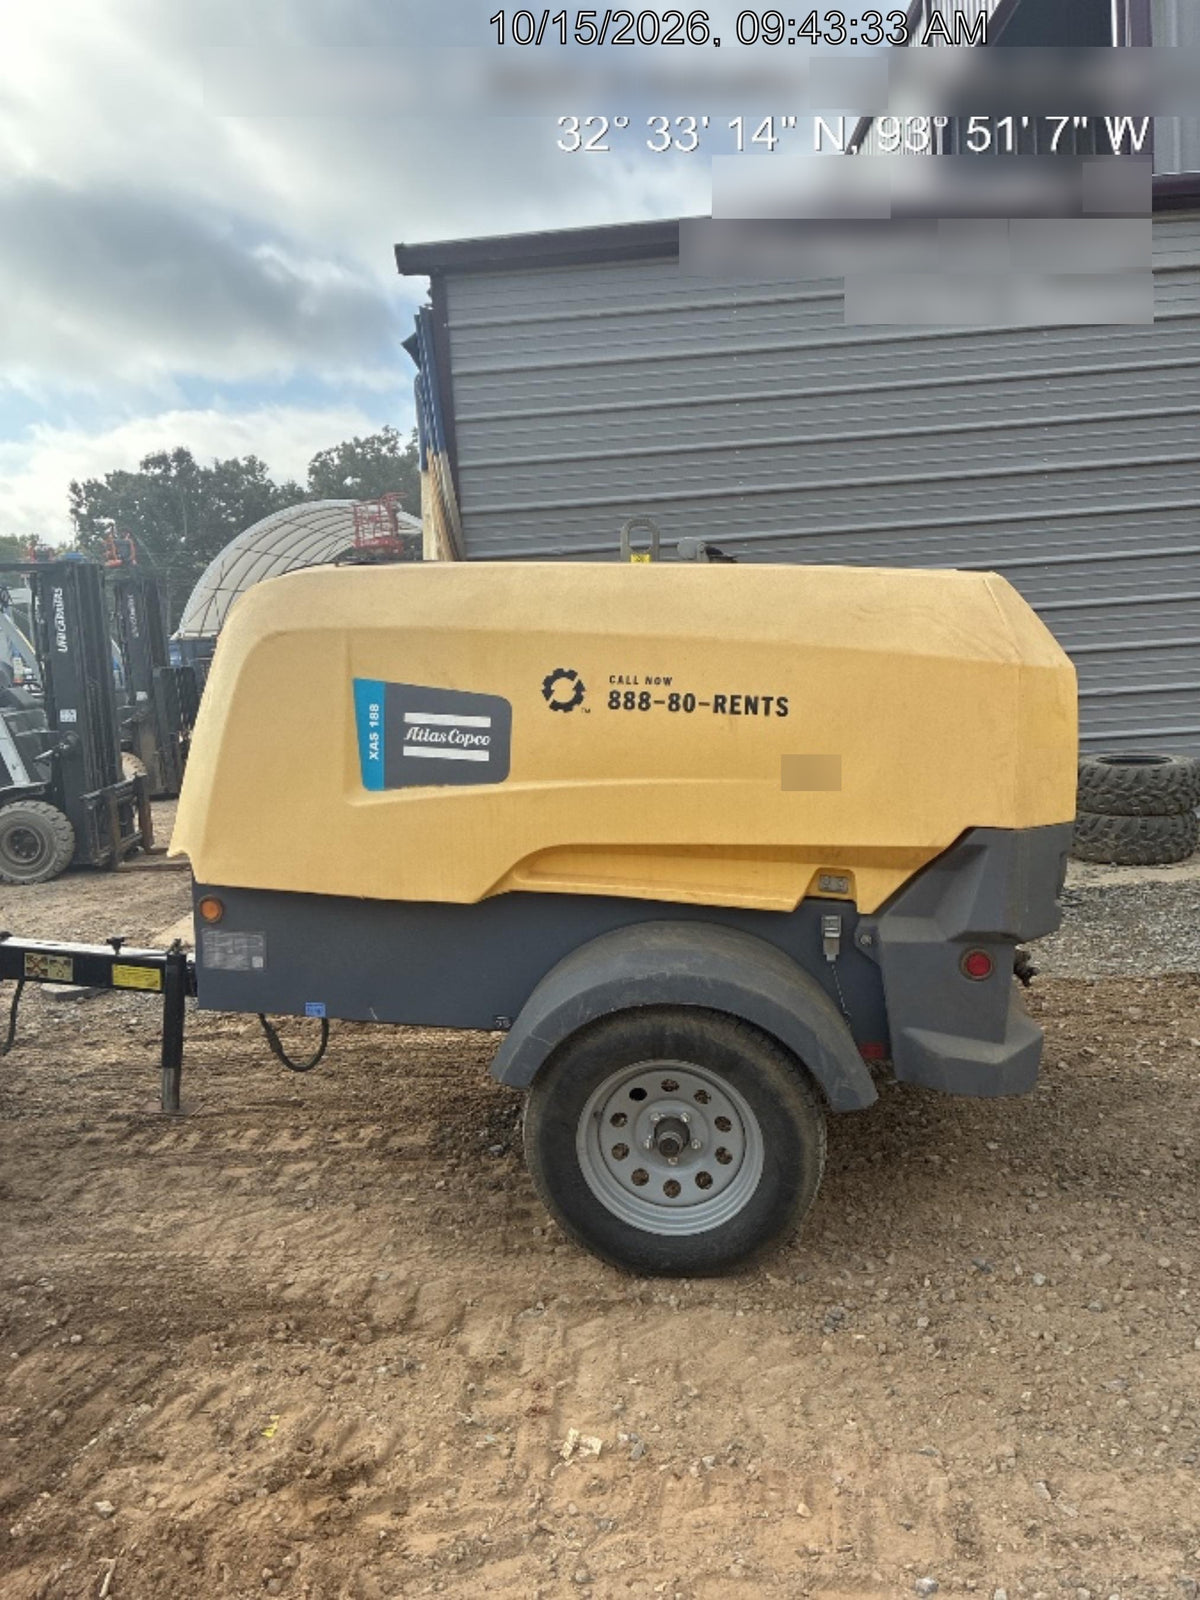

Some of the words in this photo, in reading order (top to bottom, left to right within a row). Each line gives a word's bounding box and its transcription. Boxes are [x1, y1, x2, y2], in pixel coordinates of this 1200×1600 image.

[609, 675, 639, 686] CALL
[645, 676, 673, 687] NOW
[369, 703, 379, 727] 188
[608, 690, 789, 717] 888-80-RENTS
[369, 732, 379, 760] XAS
[404, 726, 447, 744] Atlas
[449, 728, 491, 747] Copco
